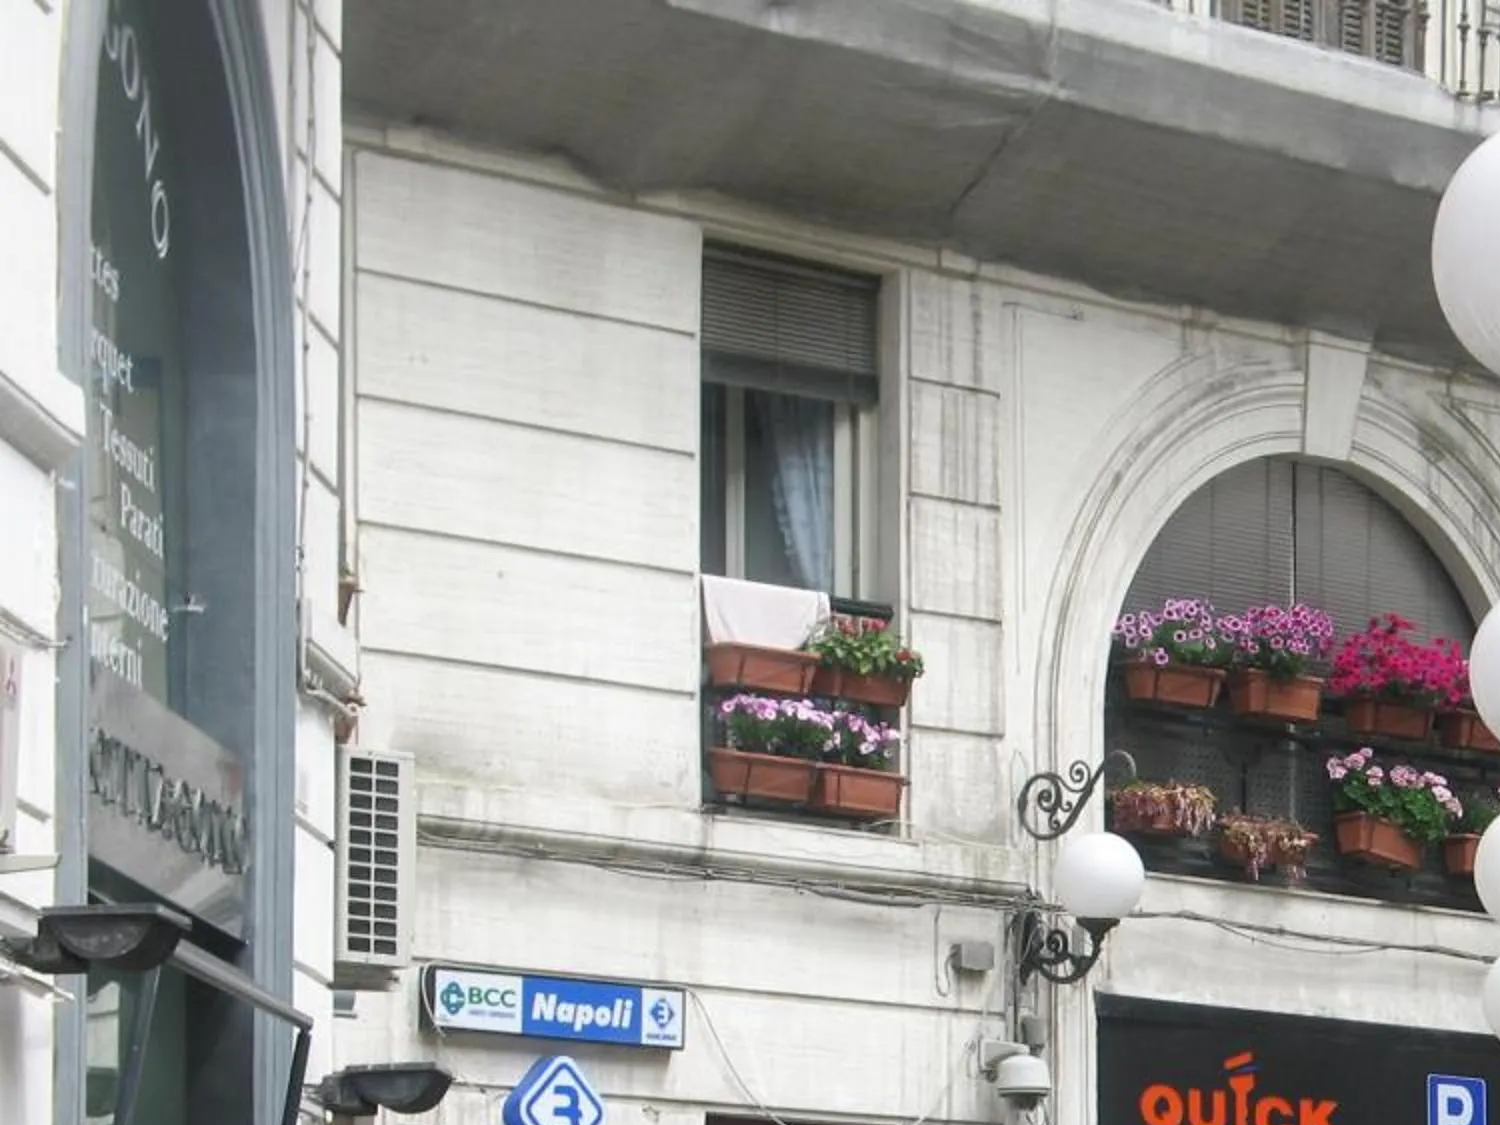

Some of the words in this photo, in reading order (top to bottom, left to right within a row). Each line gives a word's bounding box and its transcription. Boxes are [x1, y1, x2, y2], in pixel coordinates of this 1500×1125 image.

[121, 482, 164, 559] Parati
[468, 987, 516, 1008] BCC
[532, 992, 633, 1031] Napoli
